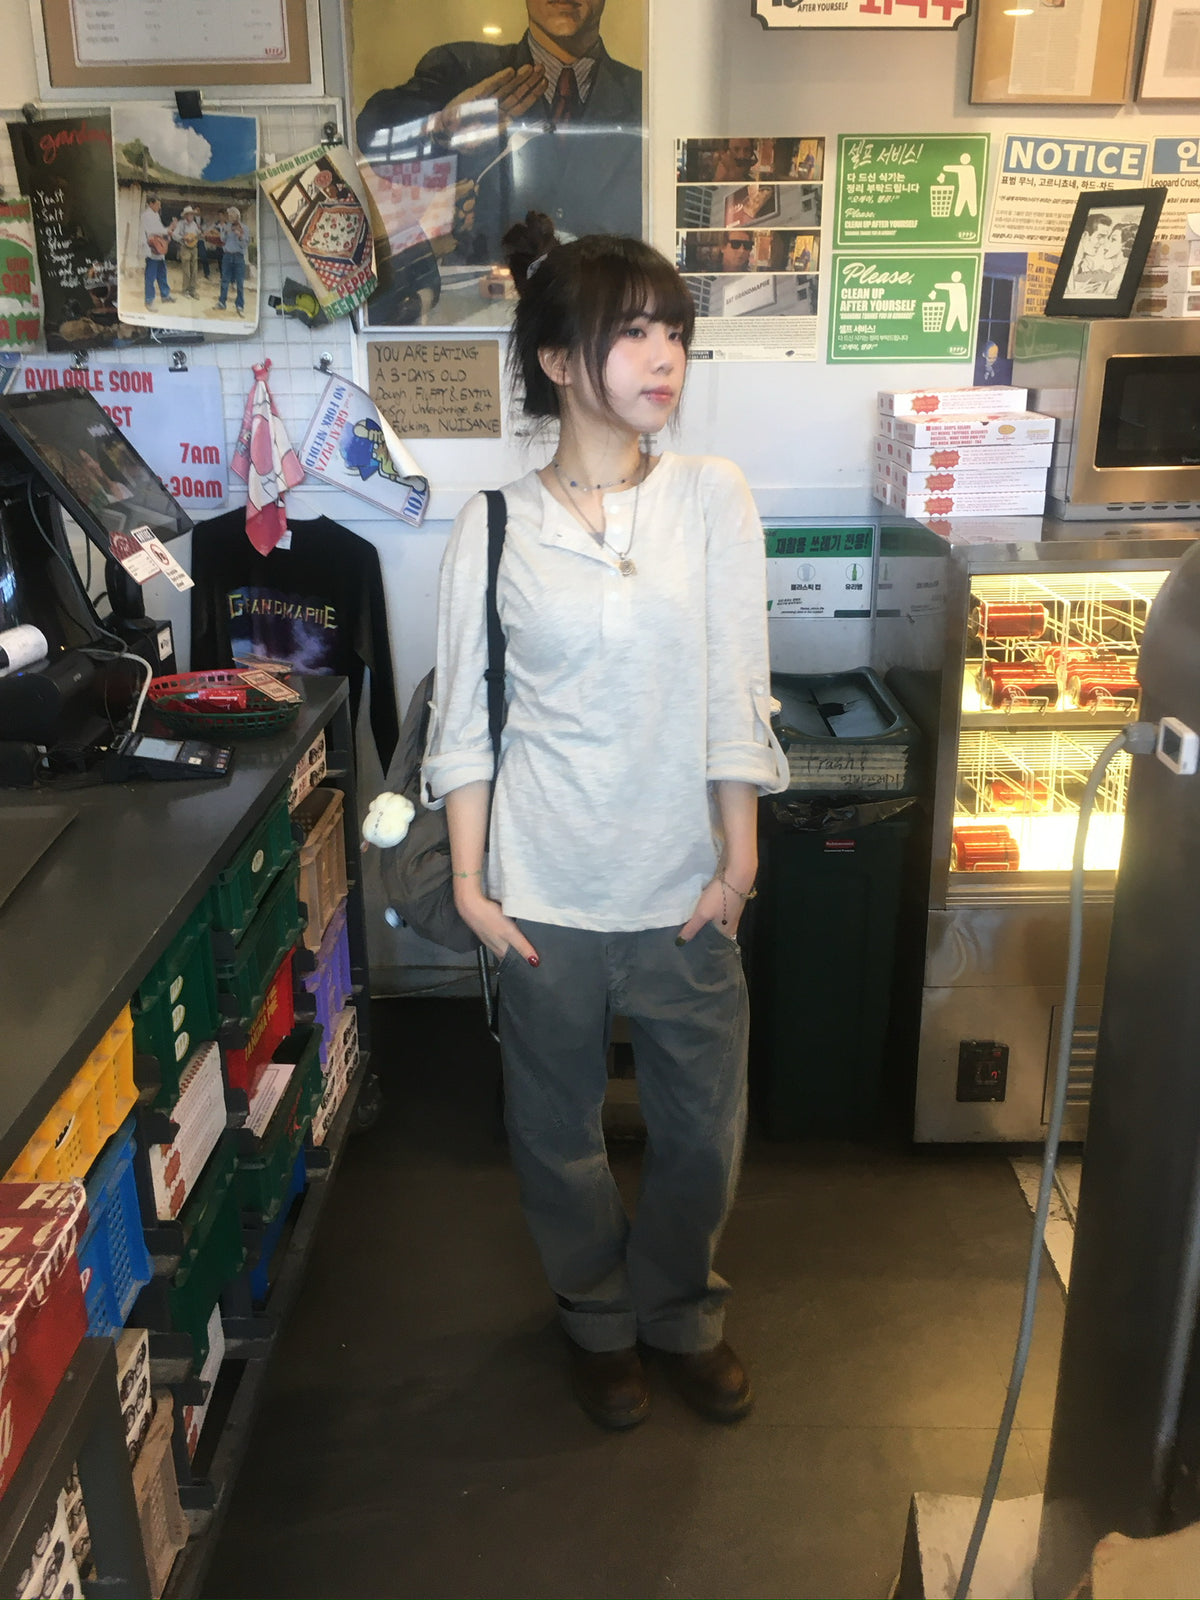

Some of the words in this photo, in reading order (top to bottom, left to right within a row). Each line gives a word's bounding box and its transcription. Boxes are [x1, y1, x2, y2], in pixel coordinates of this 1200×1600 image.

[797, 4, 816, 13] AFTER
[817, 2, 848, 12] YOURSELF
[847, 139, 874, 170] 셀프
[876, 142, 924, 166] 서비스!
[1008, 140, 1142, 176] NOTICE
[847, 173, 856, 183] 다
[858, 172, 876, 183] 드신
[879, 172, 905, 183] 식기는
[1001, 175, 1016, 186] 표범
[1150, 177, 1180, 188] Leopard
[867, 183, 920, 194] 부탁드립니다
[42, 207, 64, 222] Salt
[844, 220, 862, 228] CLEAN
[862, 220, 872, 228] UP
[871, 220, 889, 228] AFTER
[889, 220, 919, 228] YOURSELF
[841, 288, 870, 300] CLEAN
[871, 288, 885, 300] UP
[840, 300, 868, 312] AFTER
[870, 299, 916, 312] YOURSELF
[374, 344, 399, 363] YOU
[402, 344, 428, 363] ARE
[432, 345, 479, 362] EATING
[108, 369, 154, 393] SOON
[375, 367, 386, 382] A
[390, 367, 436, 383] 3-DAYS
[440, 369, 468, 383] OLD
[332, 385, 347, 400] NO
[320, 401, 341, 427] FORK
[329, 409, 349, 441] GREAT
[180, 442, 220, 465] 7AM
[304, 429, 328, 468] NEEDED
[315, 441, 336, 472] PIZZA
[157, 475, 223, 498] :30AM
[402, 487, 426, 518] YOU
[775, 537, 807, 555] 재활용
[809, 534, 841, 552] 쓰레기
[843, 532, 870, 551] 전용!
